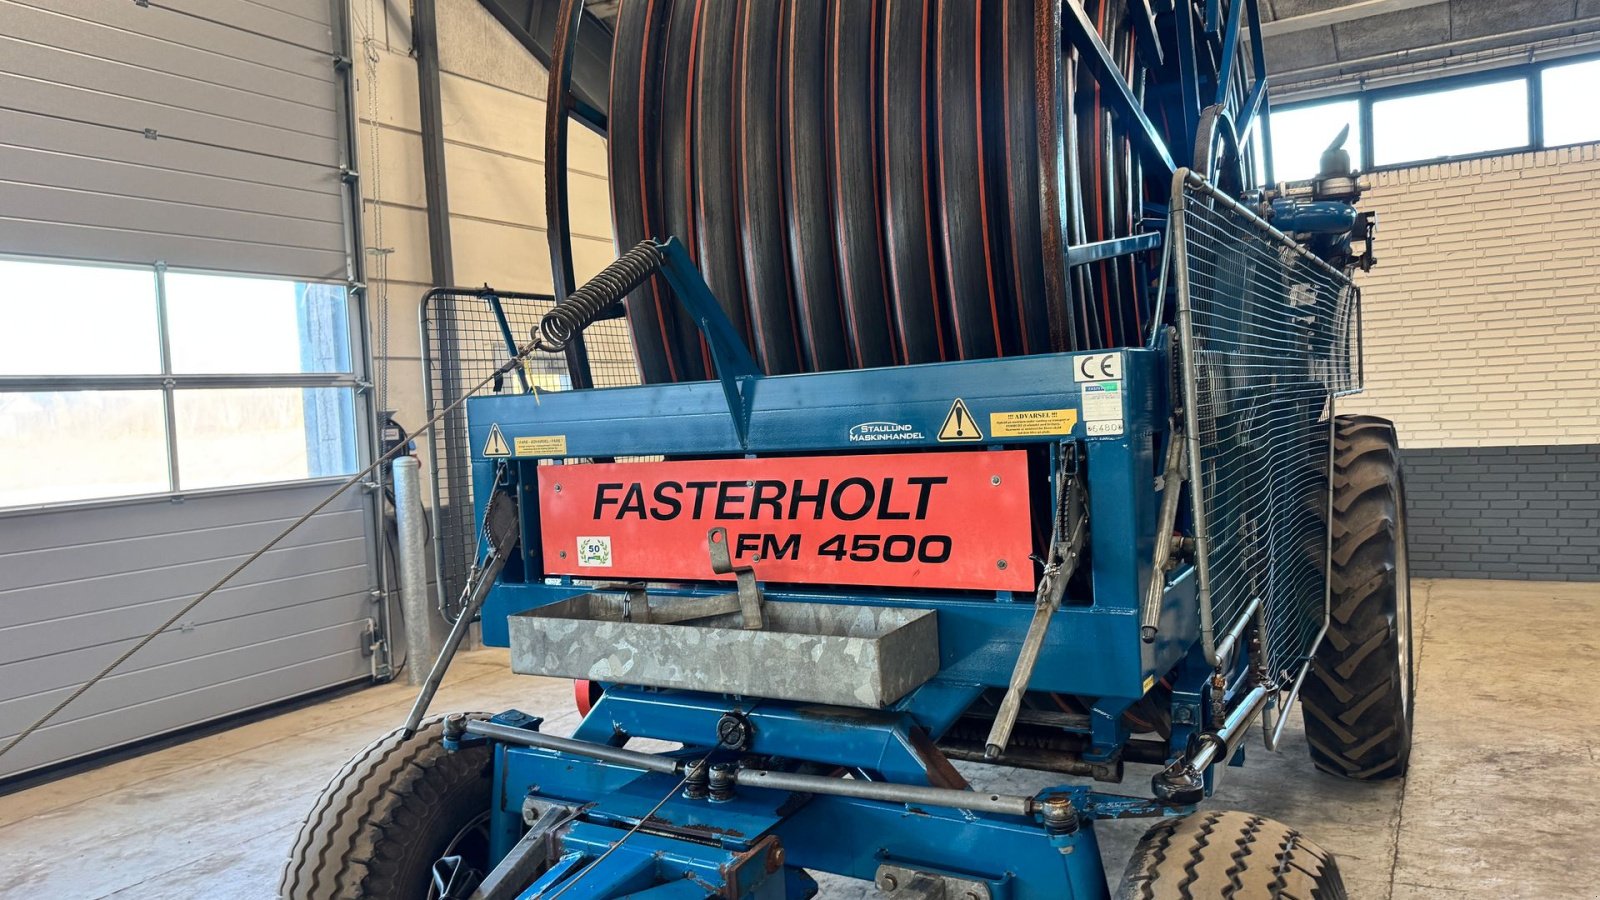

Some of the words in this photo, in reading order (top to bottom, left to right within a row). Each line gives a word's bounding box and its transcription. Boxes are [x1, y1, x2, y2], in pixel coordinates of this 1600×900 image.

[1081, 354, 1114, 379] CE
[1015, 412, 1051, 420] ADVARSEL
[861, 424, 912, 433] STAULUND
[1092, 423, 1119, 433] 6480
[849, 432, 926, 442] MASKINHANDEL
[594, 477, 947, 520] FASTERHOLT
[588, 545, 600, 553] 50
[735, 534, 801, 562] FM
[818, 534, 952, 563] 4500
